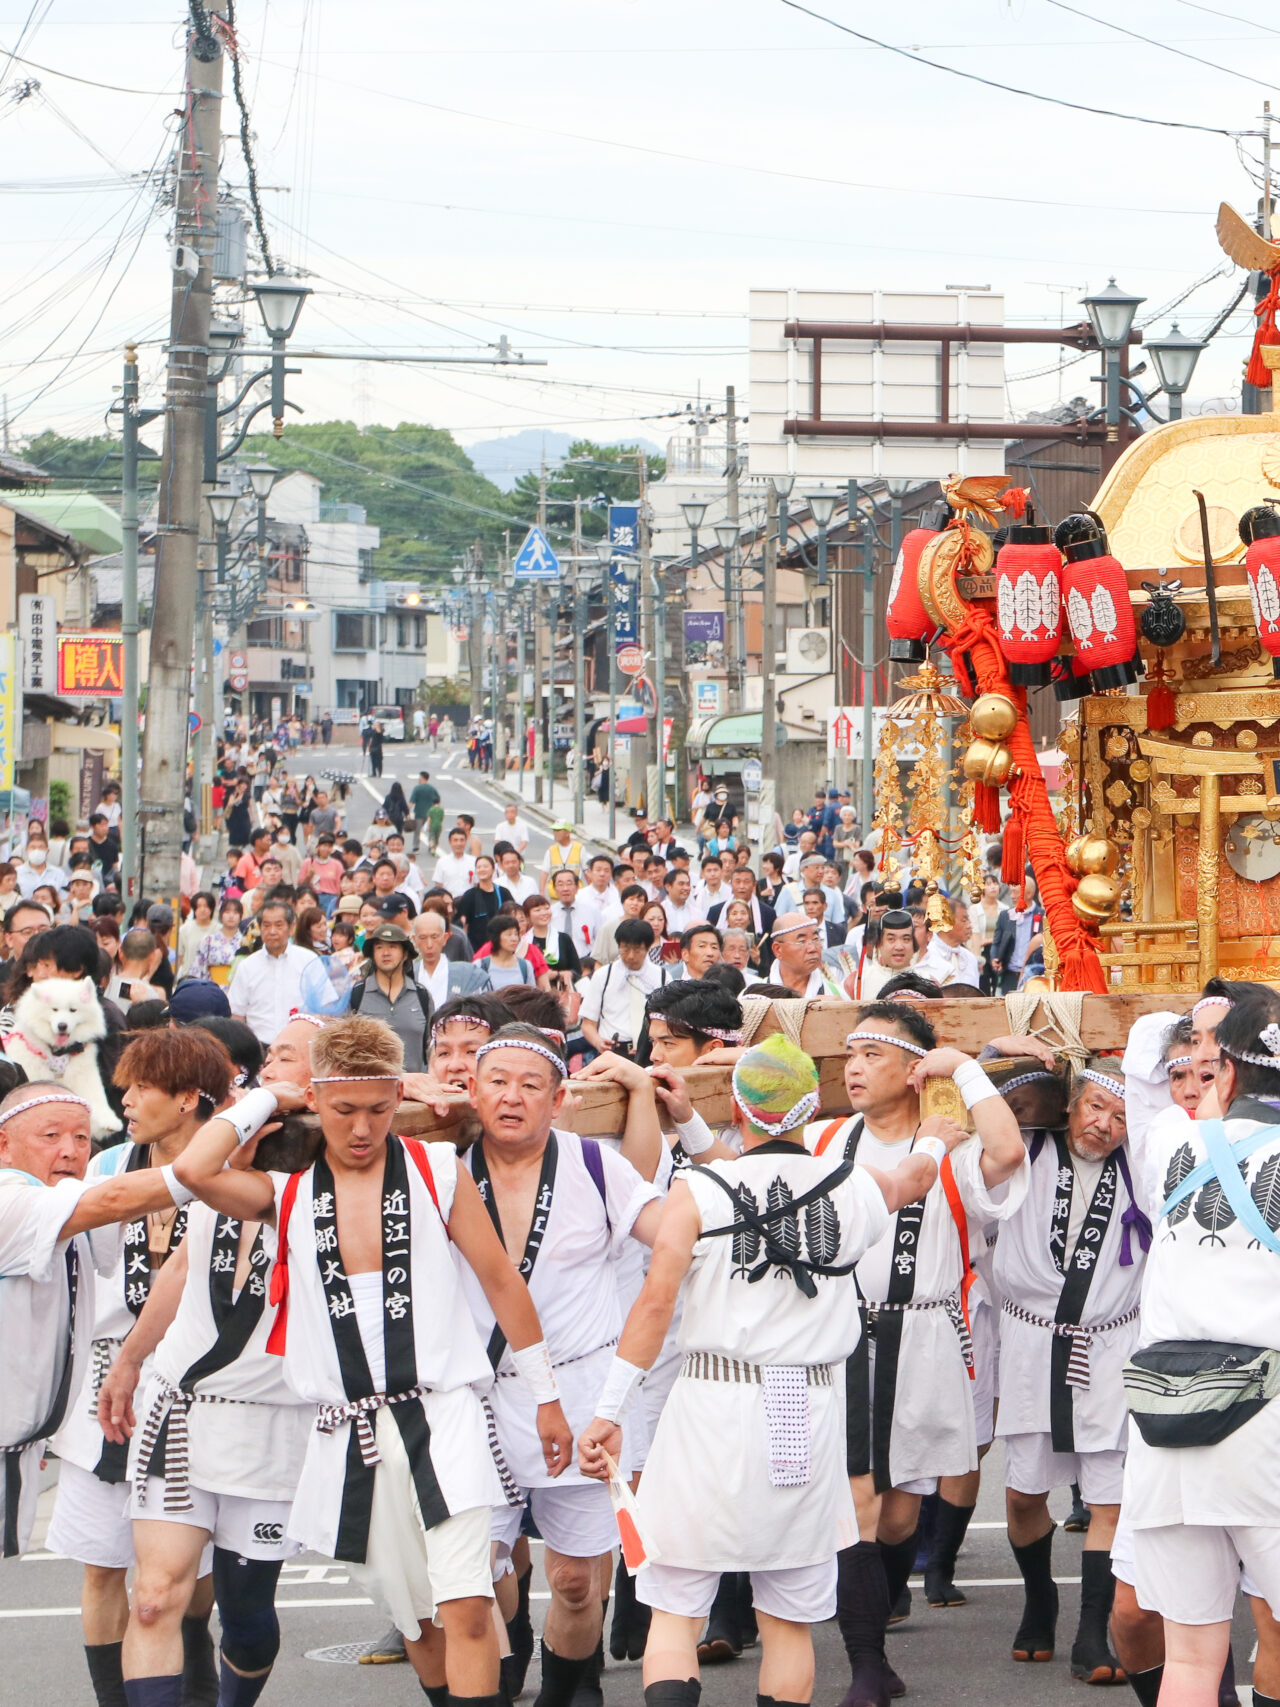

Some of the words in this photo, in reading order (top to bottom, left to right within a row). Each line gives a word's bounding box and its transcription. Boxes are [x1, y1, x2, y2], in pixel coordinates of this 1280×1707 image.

[313, 1191, 356, 1319] 建部大社
[383, 1189, 411, 1320] 近江一の宮
[1074, 1165, 1116, 1271] 近江一の宮
